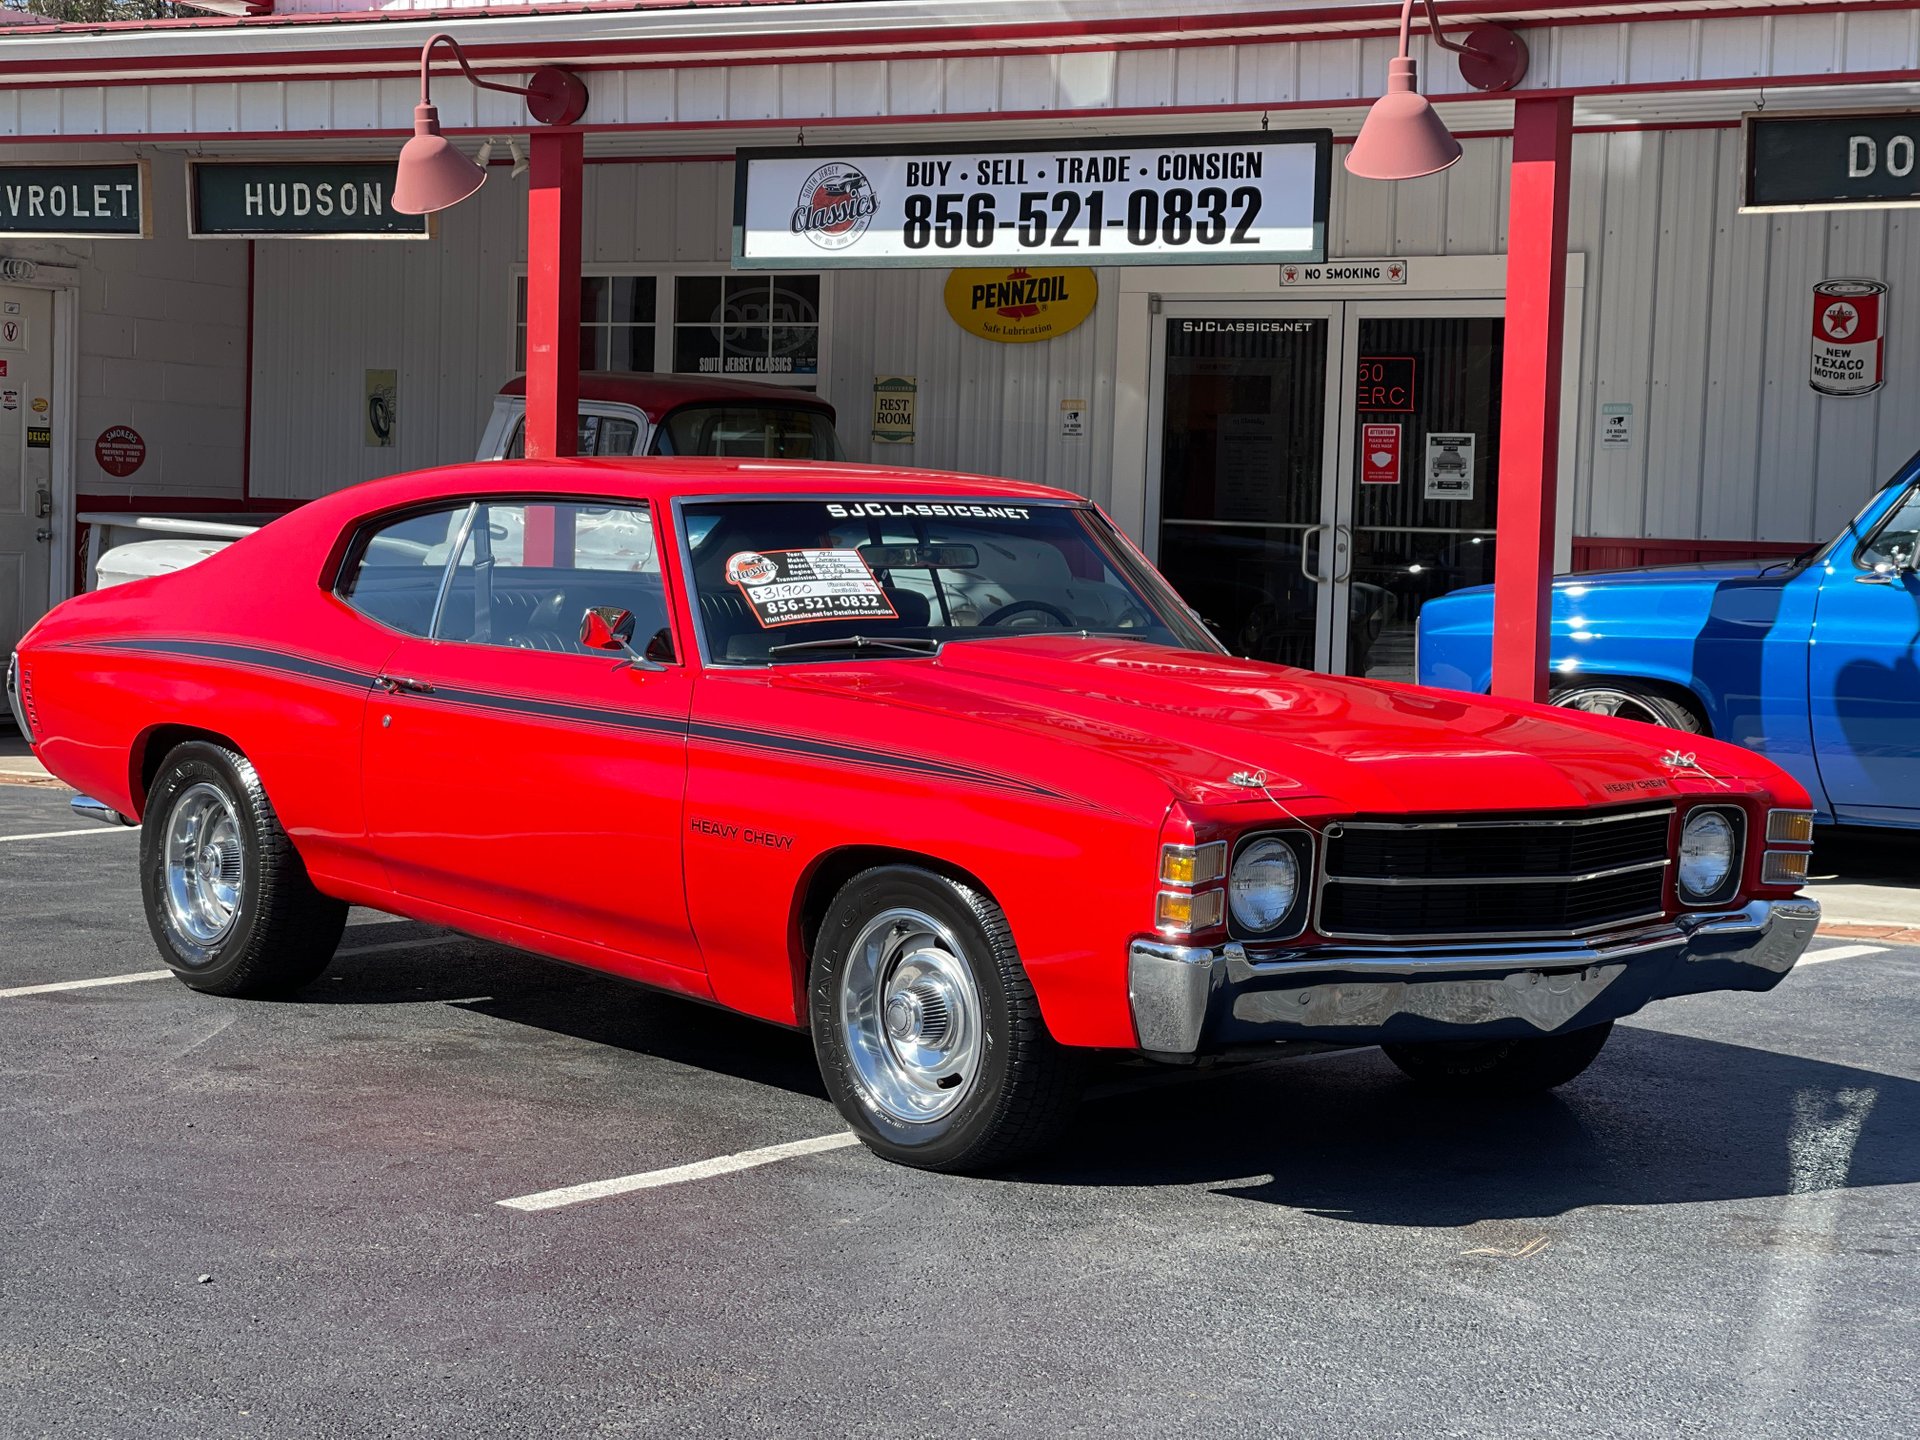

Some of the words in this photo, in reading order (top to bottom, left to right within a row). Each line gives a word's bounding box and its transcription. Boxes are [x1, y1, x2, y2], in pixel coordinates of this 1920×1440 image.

[1848, 135, 1915, 178] DO
[906, 161, 952, 187] BUY
[977, 159, 1028, 186] SELL
[1055, 156, 1131, 184] TRADE
[1157, 151, 1263, 181] CONSIGN
[803, 177, 819, 199] SOUTH
[818, 165, 840, 180] JERSEY
[0, 184, 133, 217] VROLET
[244, 182, 382, 216] HUDSON
[790, 191, 881, 236] Classics
[903, 185, 1262, 249] 856-521-0832
[1305, 268, 1321, 280] NO
[1326, 267, 1381, 279] SMOKING
[971, 275, 1069, 310] PENNZOIL
[982, 321, 1001, 334] Safe
[1002, 323, 1053, 336] Lubrication
[1826, 347, 1851, 358] NEW
[725, 357, 754, 372] JERSEY
[755, 357, 792, 372] CLASSICS
[1814, 354, 1864, 370] TEXACO
[1814, 366, 1846, 380] MOTOR
[1848, 371, 1864, 380] OIL
[880, 398, 910, 411] REST
[876, 412, 912, 425] ROOM
[28, 431, 50, 441] DELCO
[106, 429, 137, 443] SMOKERS
[729, 561, 779, 582] Classics
[766, 595, 880, 614] 856-521-0832
[764, 615, 780, 624] Visit
[780, 612, 824, 622] SJClassics.net
[833, 609, 859, 617] Detailed
[858, 608, 893, 616] Description
[1604, 782, 1636, 793] HEAVY
[1637, 778, 1667, 789] CHEVY
[690, 817, 739, 839] HEAVY
[743, 828, 794, 850] CHEVY
